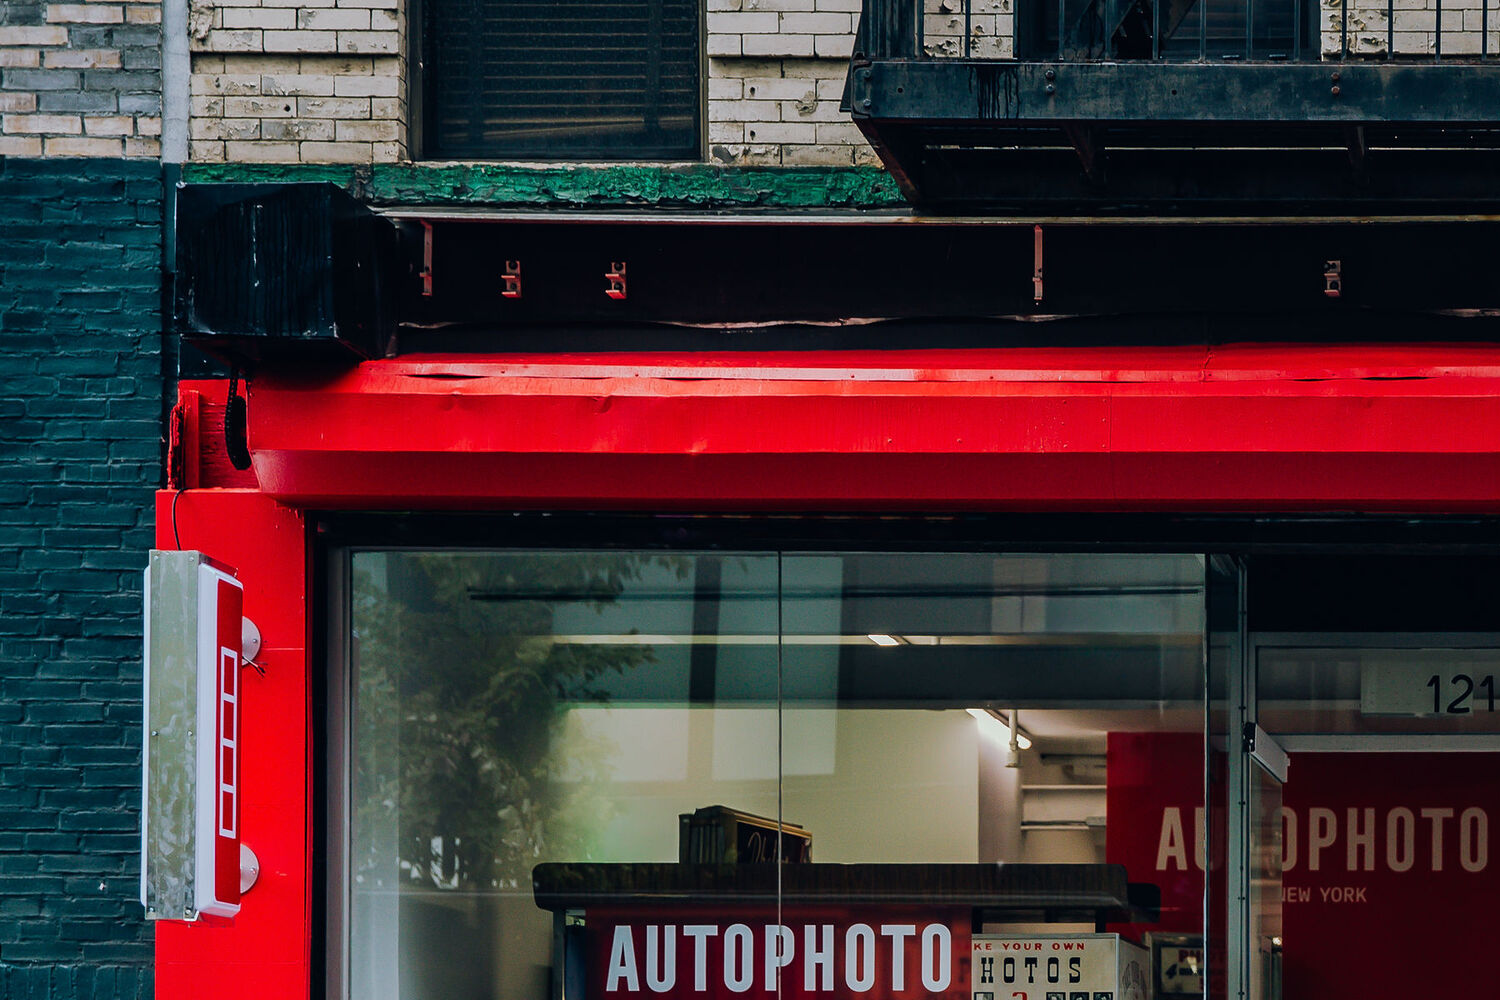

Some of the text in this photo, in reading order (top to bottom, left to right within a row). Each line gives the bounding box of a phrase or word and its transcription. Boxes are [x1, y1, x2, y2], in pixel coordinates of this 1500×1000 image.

[1426, 674, 1495, 713] 121
[1156, 806, 1489, 872] AUOPHOTO
[1320, 887, 1367, 903] YORK
[606, 923, 952, 993] AUTOPHOTO
[1003, 942, 1043, 951] YOUR
[1052, 942, 1085, 951] OWN
